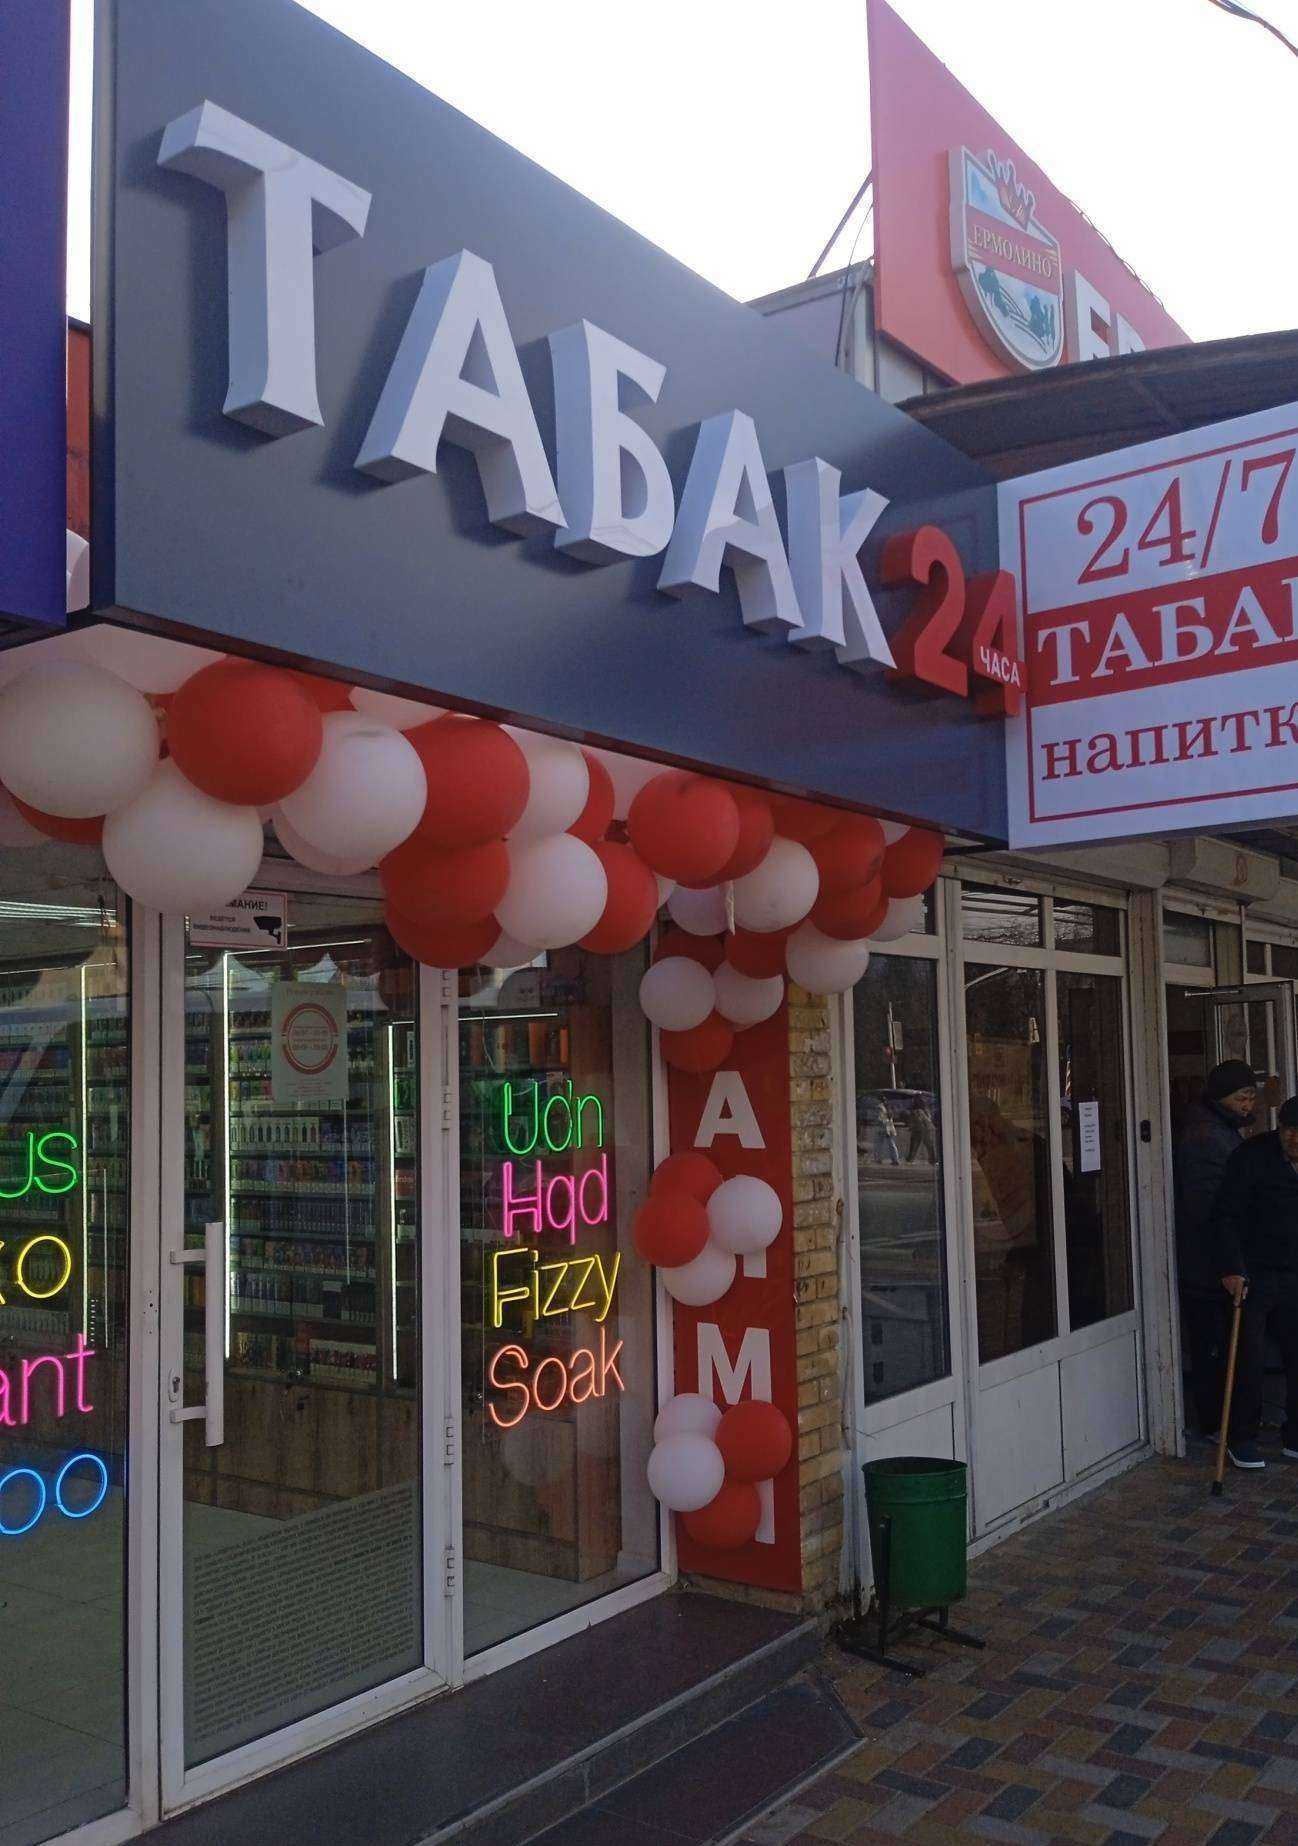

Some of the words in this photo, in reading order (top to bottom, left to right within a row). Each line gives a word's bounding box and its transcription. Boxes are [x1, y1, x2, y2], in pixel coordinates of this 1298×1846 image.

[972, 224, 1053, 279] ЕРМОЛИНО
[158, 99, 898, 672] ТАБАК
[892, 524, 1022, 716] 24
[1074, 448, 1297, 586] 24/7
[980, 645, 1021, 688] ЧАСА
[1036, 576, 1298, 688] ТАБА
[502, 1152, 610, 1246] Hqd
[491, 1247, 622, 1328] Fizzy
[487, 1327, 625, 1429] Soak
